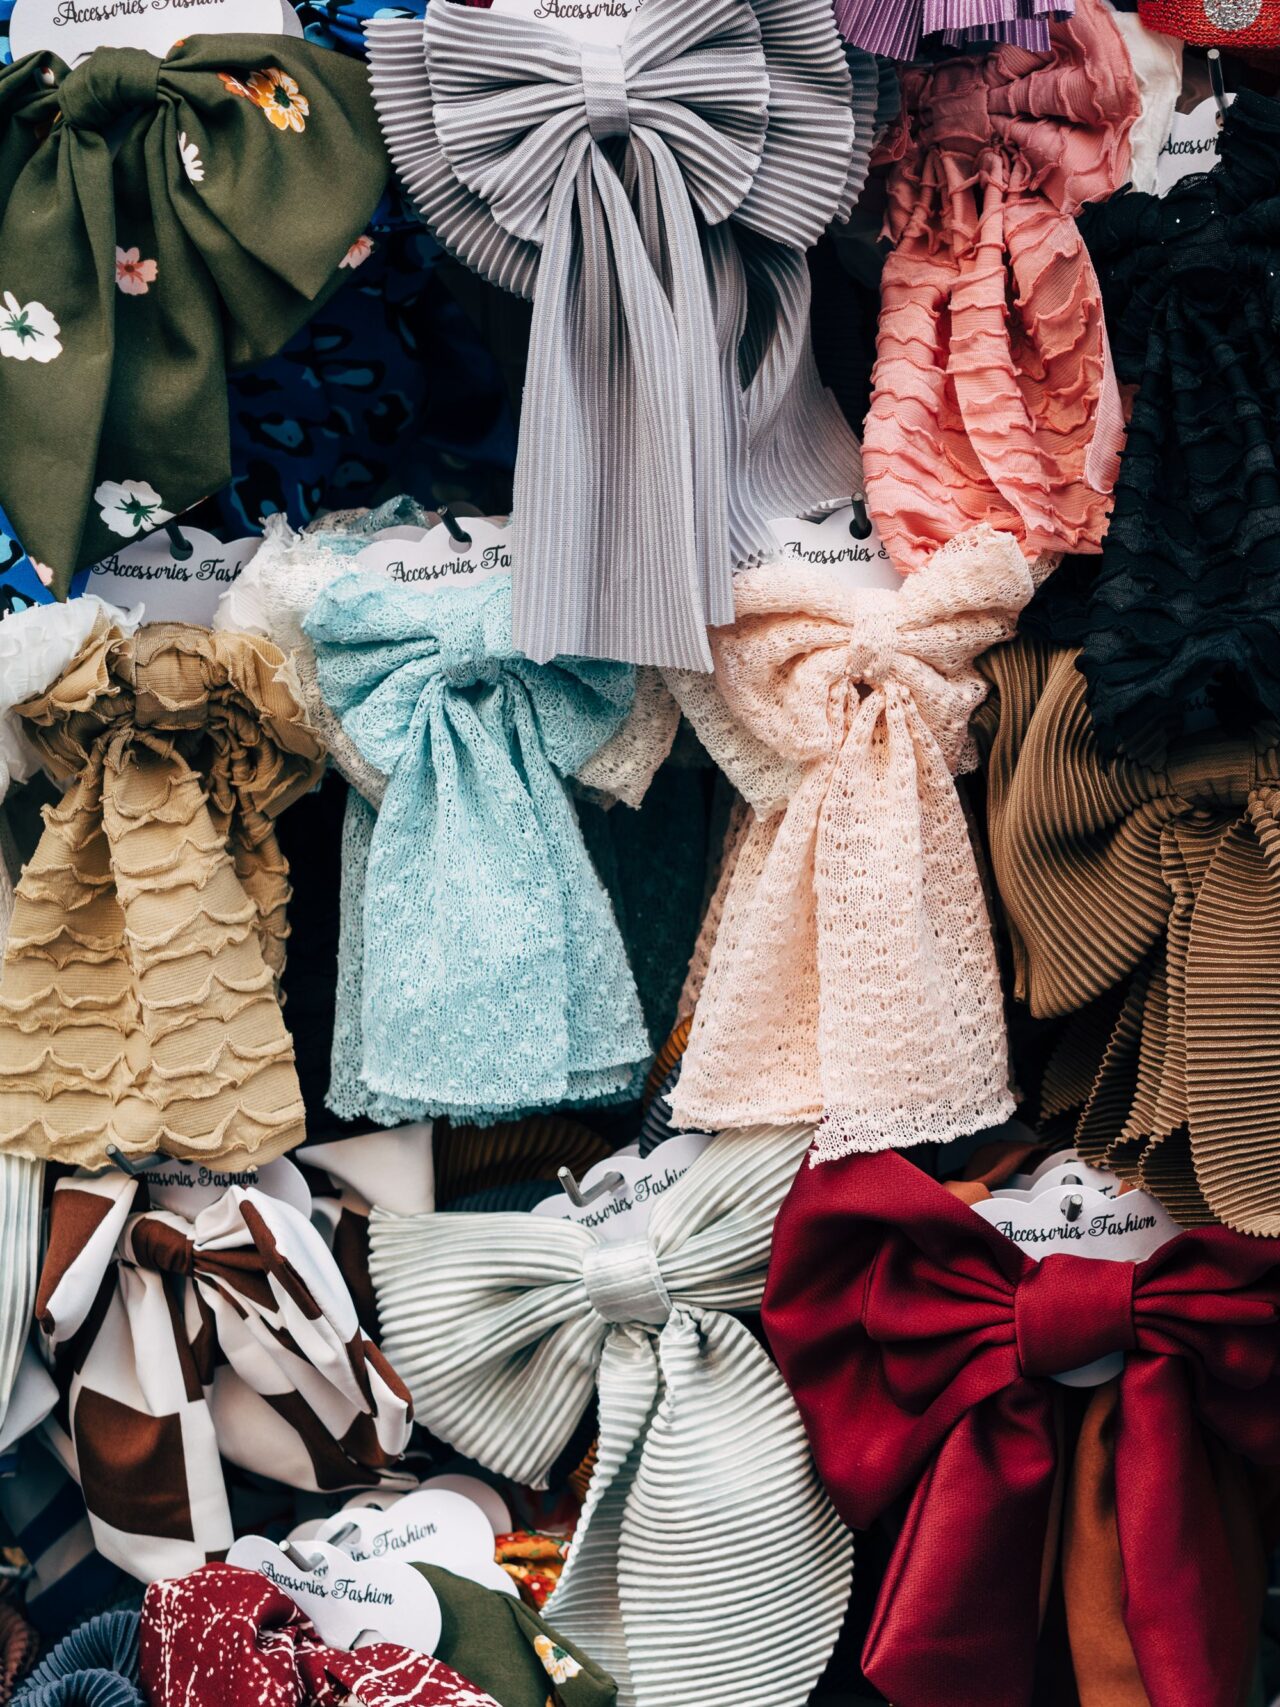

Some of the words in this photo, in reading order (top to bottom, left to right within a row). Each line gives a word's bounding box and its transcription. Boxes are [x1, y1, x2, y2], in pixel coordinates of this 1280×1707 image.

[53, 1, 148, 26] Accessories
[534, 0, 632, 19] Accessories
[1159, 133, 1218, 156] Accesso
[91, 555, 193, 581] Accessories
[196, 559, 241, 582] Fash
[386, 558, 477, 582] Accessories
[142, 1171, 196, 1187] ccessories
[634, 1168, 690, 1202] Fashi
[995, 1221, 1085, 1242] Accessories
[1088, 1212, 1157, 1237] Fashion
[373, 1521, 438, 1557] Fashion
[259, 1561, 328, 1598] Accessories
[331, 1579, 395, 1606] Fashion
